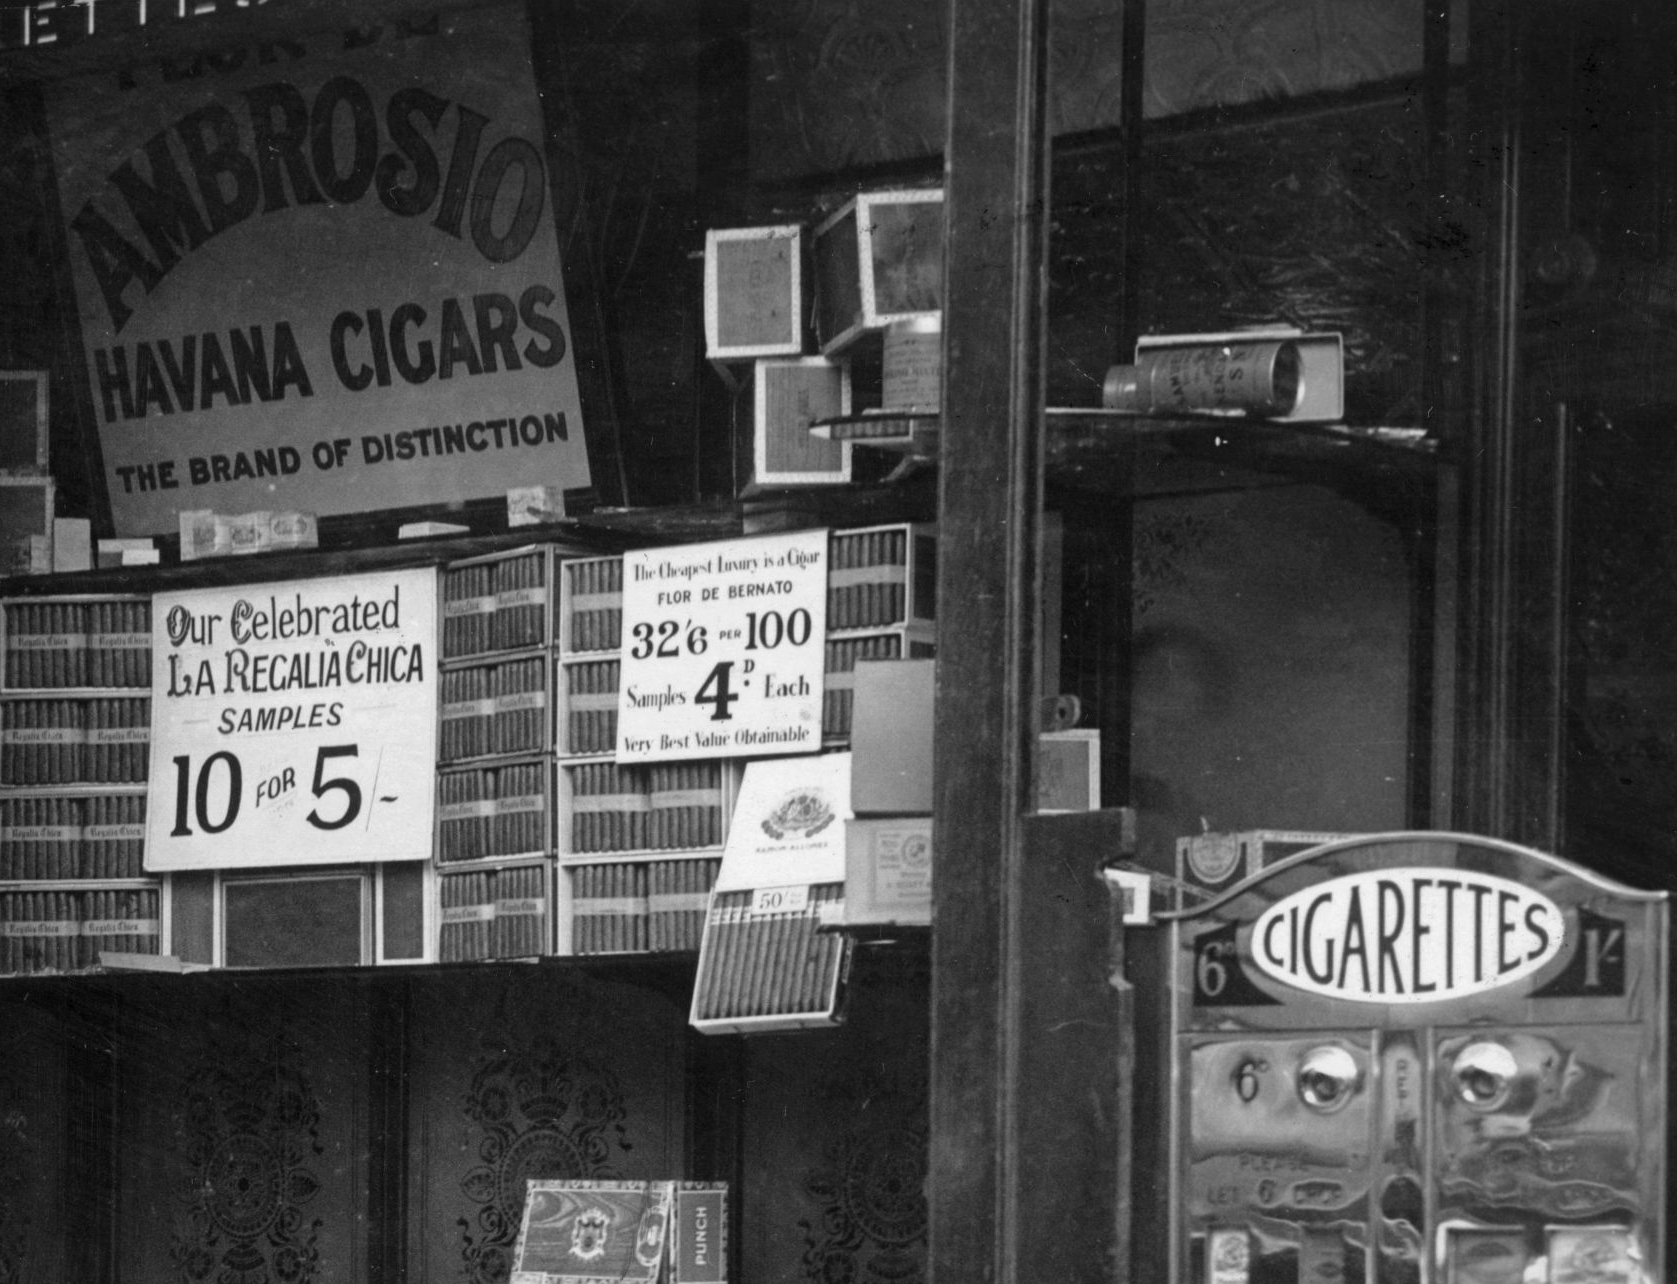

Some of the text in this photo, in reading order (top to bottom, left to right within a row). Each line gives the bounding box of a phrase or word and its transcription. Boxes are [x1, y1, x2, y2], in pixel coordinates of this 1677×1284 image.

[70, 75, 546, 334] AMBROSIO
[93, 285, 566, 424] HAVANA CIGARS
[116, 411, 569, 494] THE BRAND OF DISTINCTION
[633, 547, 820, 582] The Cheapest Luxury is a Cigar
[658, 580, 793, 606] FLOR DE BERNATO
[166, 604, 222, 647] Our
[230, 584, 400, 645] Celebrated
[719, 629, 742, 641] PER
[744, 607, 812, 651] 100
[166, 640, 424, 697] LA REGALIA CHICA
[627, 684, 686, 711] Samples
[764, 673, 811, 699] Each
[218, 702, 344, 735] SAMPLES
[624, 724, 811, 756] Very Best Value Obtainable
[170, 750, 243, 837] 10
[255, 766, 296, 808] FOR
[1264, 878, 1549, 995] CIGARETTES
[695, 1206, 708, 1266] PUNCH
